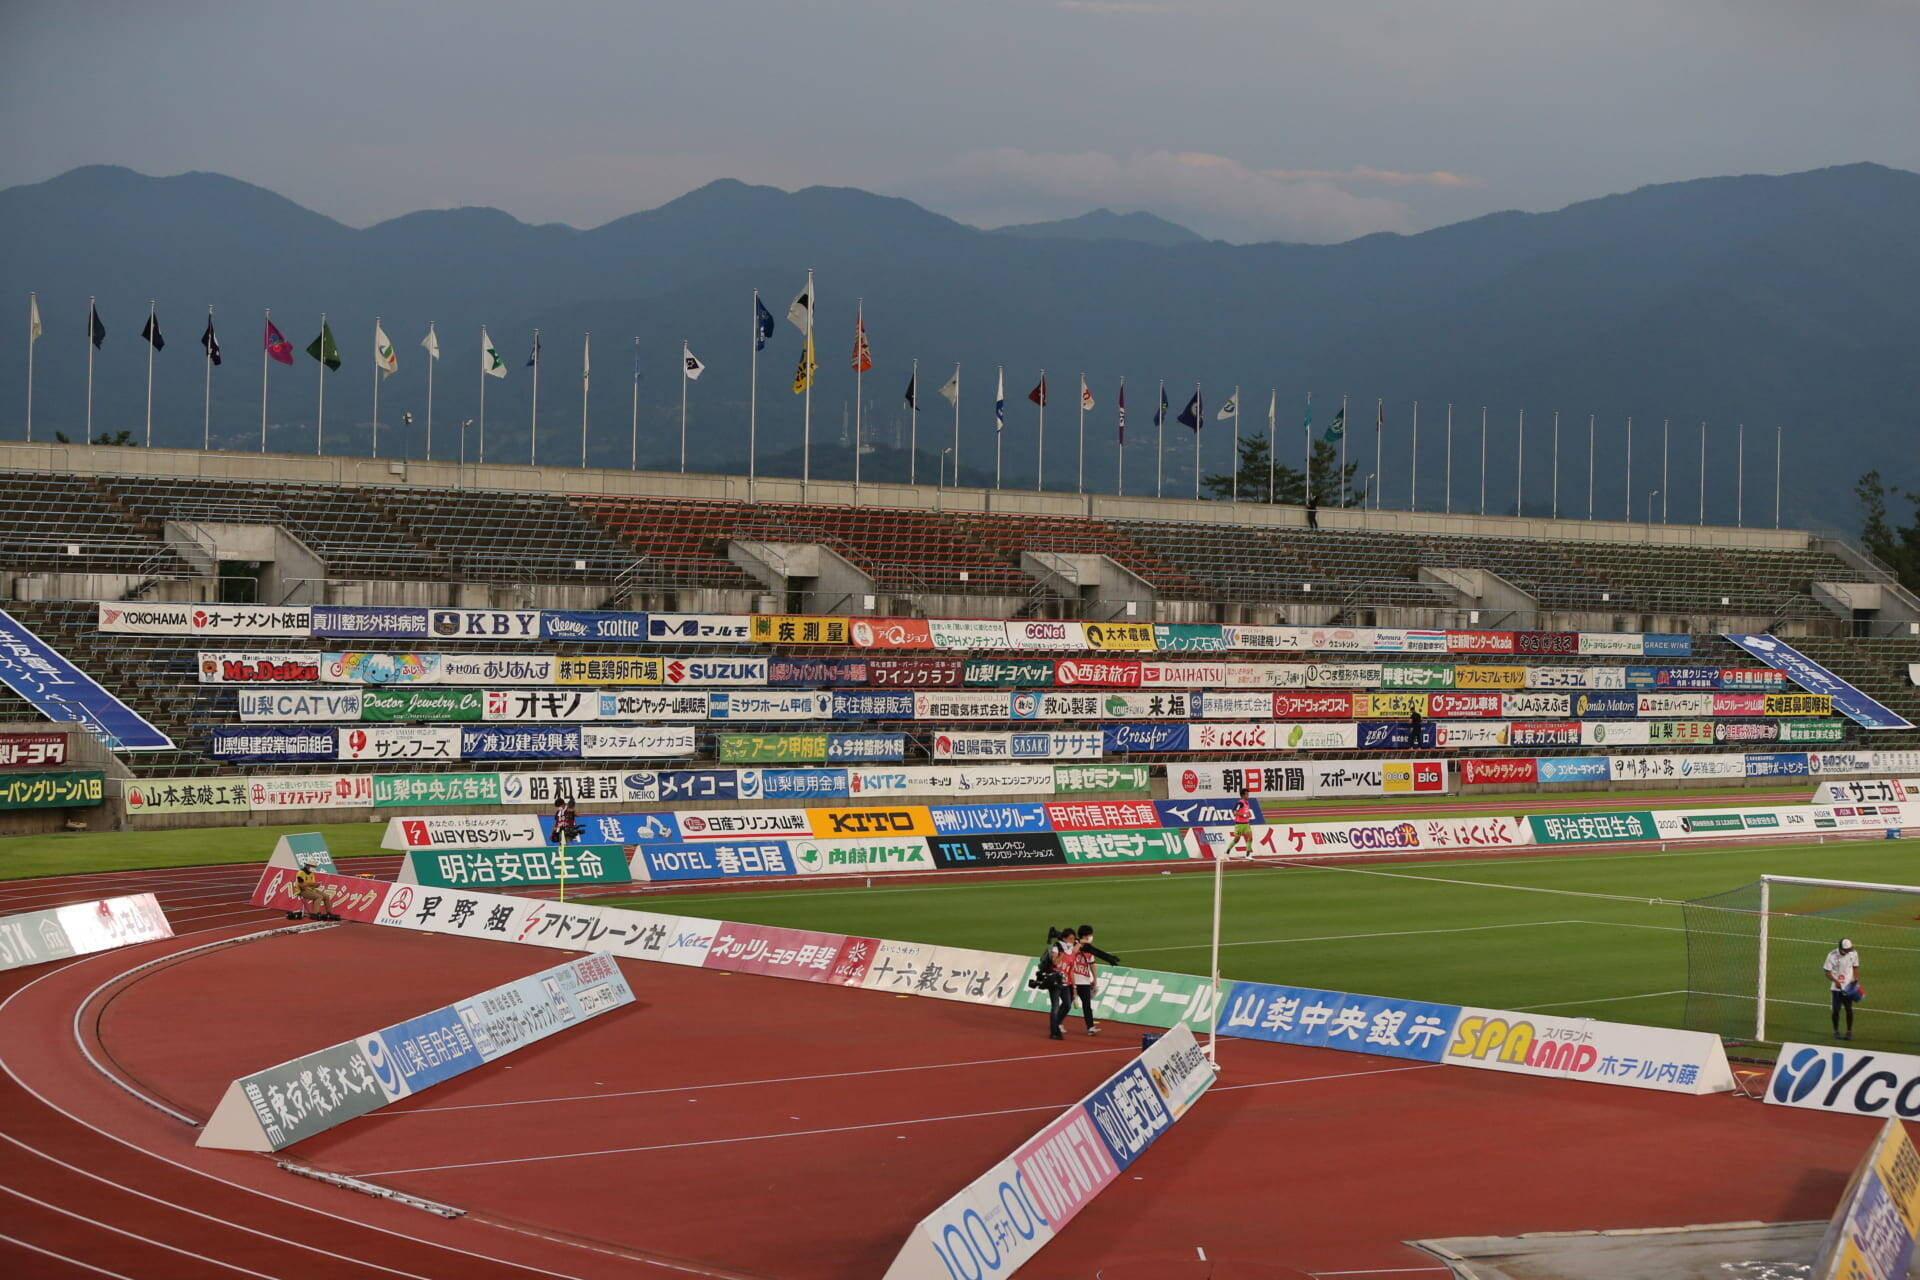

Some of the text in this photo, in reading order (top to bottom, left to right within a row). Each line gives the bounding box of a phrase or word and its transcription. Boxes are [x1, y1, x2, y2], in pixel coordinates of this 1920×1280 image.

[122, 611, 188, 626] YOKOHAMA
[209, 611, 310, 629] オーナメント依田
[313, 612, 426, 632] 貢川整形外科病院
[465, 614, 536, 635] KBY
[546, 617, 588, 634] Kleenex
[597, 619, 639, 637] scottie
[700, 625, 749, 638] マルモ
[778, 621, 843, 642] 疾測量
[1026, 623, 1067, 640] CCNet
[1106, 626, 1151, 642] 大木電機
[1241, 635, 1298, 648] 甲陽建機リース
[1645, 640, 1690, 650] GRACE WINE
[484, 662, 551, 679] ありあんす
[690, 663, 765, 680] SUZUKI
[875, 669, 956, 685] ワインクラブ
[965, 662, 1054, 682] 山梨トヨペット
[1078, 663, 1139, 683] 西鉄旅行
[1165, 667, 1224, 682] DAIHATSU
[1383, 667, 1454, 687] 甲斐ゼミナール
[1669, 669, 1720, 680] 大久保クリニック
[1734, 671, 1783, 684] 日産山梨会
[1541, 674, 1587, 687] ニュースコム
[364, 694, 406, 708] Doctor
[515, 692, 582, 718] オギノ
[731, 699, 813, 715] ミサワホーム甲信
[834, 695, 913, 714] 東住機器販売
[930, 702, 1010, 717] 鶴田電気株式会社
[1044, 697, 1098, 715] 救心製薬
[1148, 695, 1185, 716] 米福
[1289, 696, 1350, 712] アドヴォネクスト
[1517, 697, 1570, 713] JAふえふき
[1576, 695, 1635, 716] Kondo Motors
[1650, 698, 1701, 713] 富士急ハイランド
[1713, 699, 1764, 712] JAフルーツ山梨
[1766, 695, 1832, 713] 矢崎耳鼻咽喉科
[484, 732, 579, 753] 渡辺建設興業
[599, 735, 694, 749] システムインナカゴミ
[1117, 725, 1168, 747] Crossfor
[1220, 725, 1266, 746] はくばく
[1448, 728, 1497, 742] ユニフルーティー
[1514, 728, 1578, 746] 東京ガス山梨
[213, 735, 334, 755] 山梨県建設業協同組合
[843, 739, 905, 757] 今井整形外科
[952, 739, 1007, 755] 旭陽電気
[1013, 739, 1049, 754] SASAKI
[1053, 734, 1102, 756] ササキ
[1056, 768, 1147, 790] 甲斐ゼミナール
[1320, 769, 1382, 787] スポーツくじ
[1474, 763, 1533, 779] ベルクラシック
[335, 777, 372, 799] 中川
[375, 778, 498, 801] 山梨中央広告社
[530, 776, 618, 800] 昭和建設
[661, 775, 735, 797] メイコー
[765, 777, 846, 793] 山梨信用金庫
[863, 774, 907, 790] KITZ
[929, 776, 952, 786] キッツ
[1222, 768, 1305, 793] 朝日新聞
[146, 785, 249, 808] 山本基礎工業
[628, 791, 656, 799] MEIKO
[1849, 781, 1894, 802] サニカ
[709, 815, 805, 832] 日産プリンス山梨
[829, 810, 915, 832] KITO
[934, 807, 1046, 831] 甲州リハビリグループ
[1050, 804, 1157, 828] 甲府信用金庫
[1658, 820, 1678, 830] 2020
[1787, 815, 1805, 824] DAZN
[431, 827, 536, 845] 山日YBSグループ
[1322, 830, 1349, 844] NNS
[1349, 822, 1420, 849] CCNet光
[1454, 819, 1513, 845] はくばく
[1544, 815, 1645, 841] 明治安田生命
[939, 843, 977, 861] TEL
[982, 841, 1026, 850] 東京エレクトロン
[1063, 836, 1183, 865] 甲斐ゼミナール
[652, 845, 787, 875] HOTEL 春日居
[829, 844, 926, 866] 内藤ハウス
[437, 849, 603, 883] 明治安田生命
[416, 895, 514, 932] 早野組
[540, 911, 667, 952] アドブレーン社
[667, 932, 713, 950] Netz
[711, 933, 839, 970] ネッツトヨタ甲斐
[873, 955, 1014, 1001] 十六穀ごはん
[1227, 992, 1447, 1049] 山梨中央銀行
[1449, 1014, 1598, 1074] SPA LAND
[1542, 1027, 1594, 1044] スパランド
[393, 1022, 473, 1079] 山梨信用金庫
[1597, 1055, 1701, 1087] ホテル内藤
